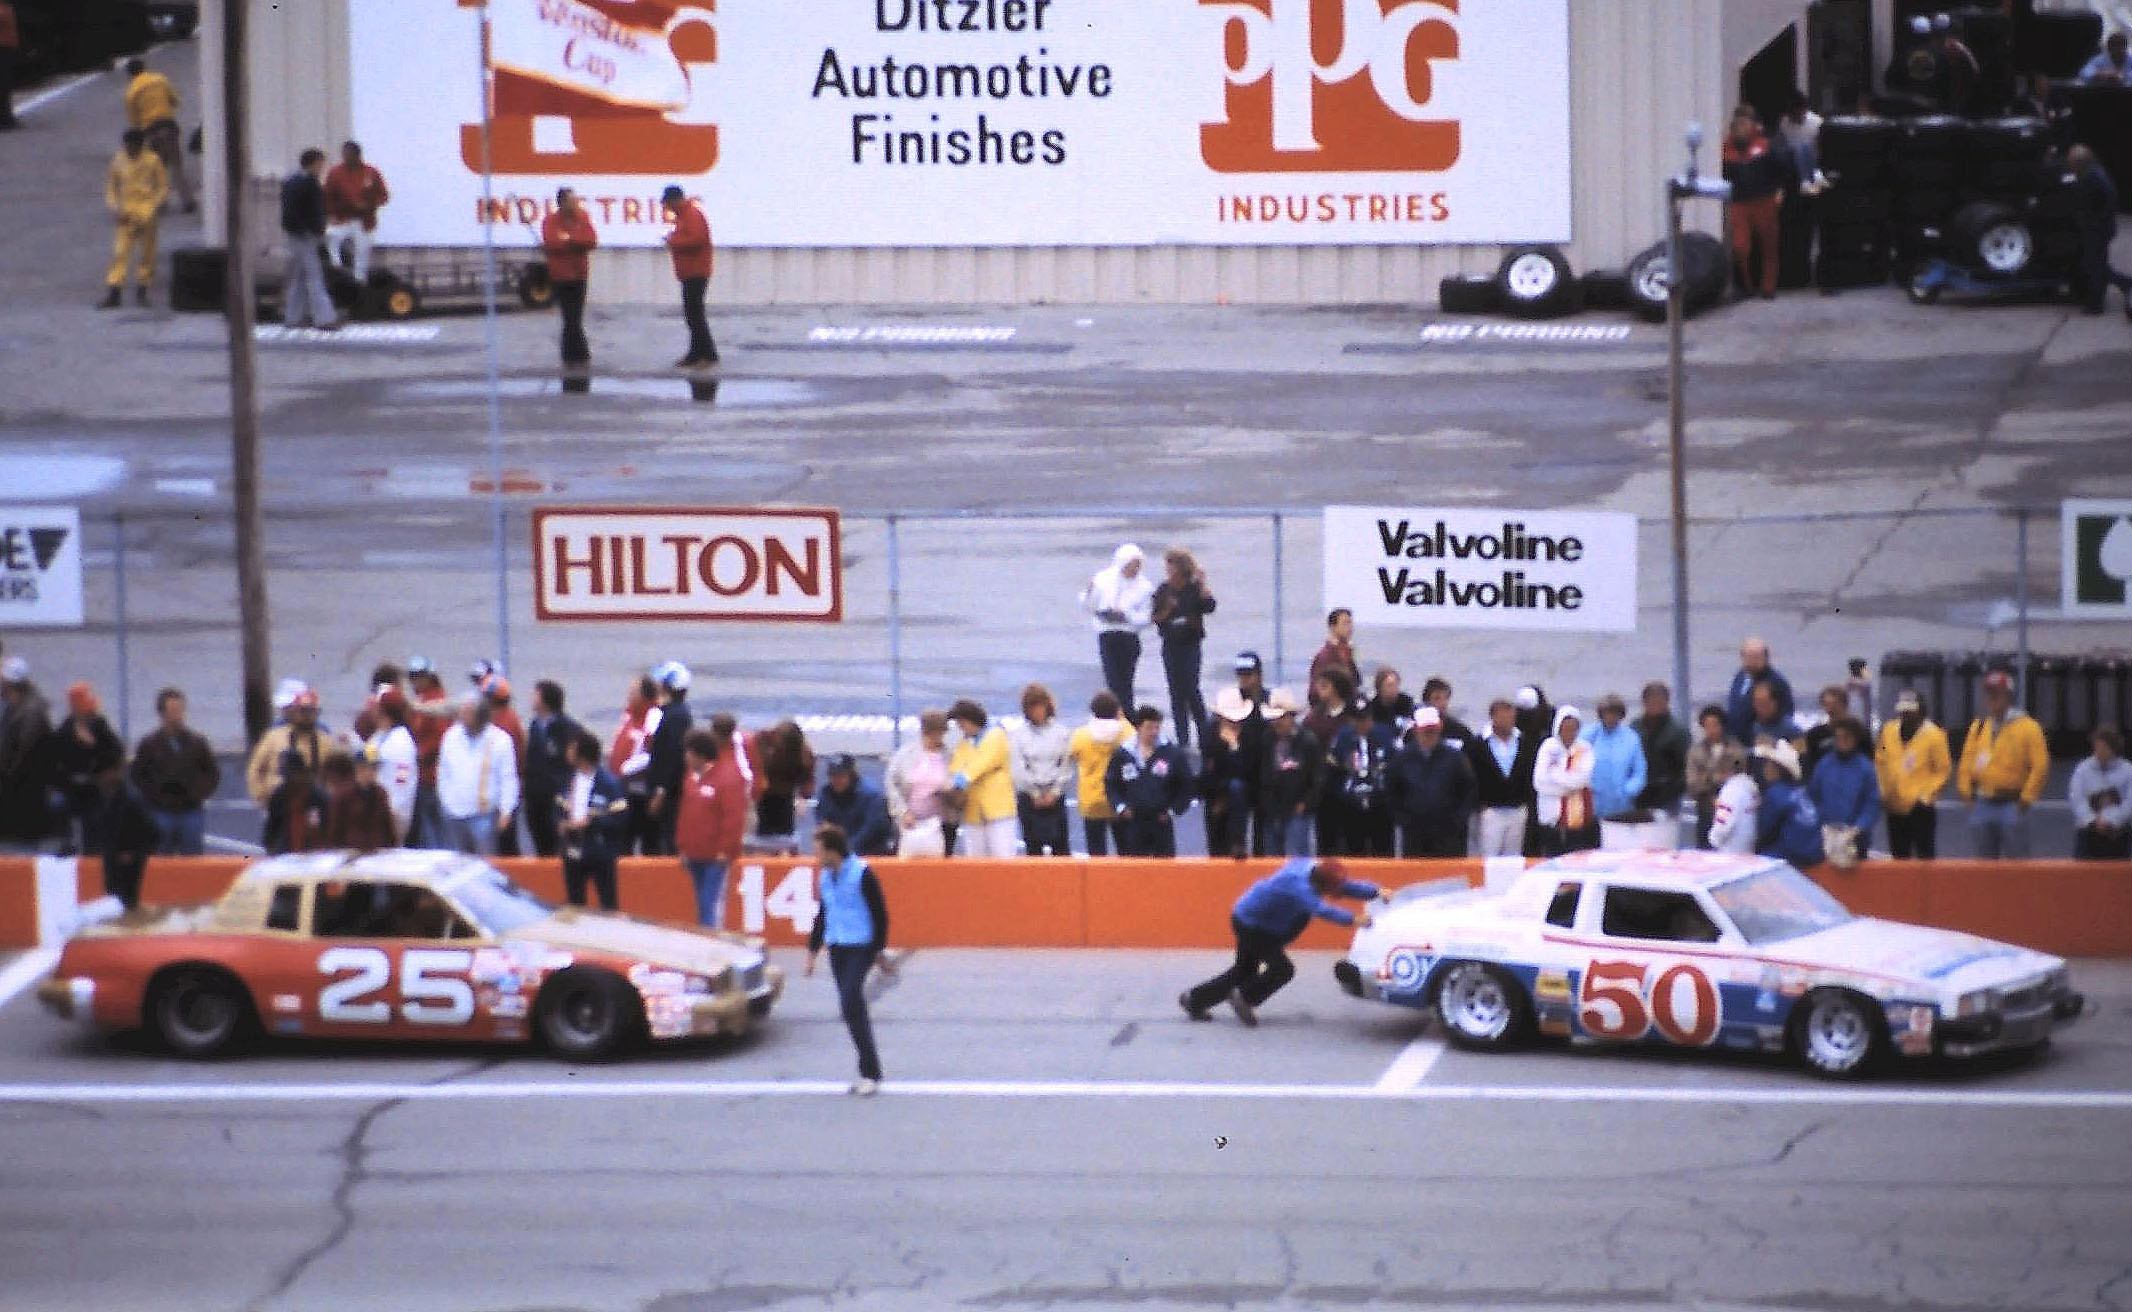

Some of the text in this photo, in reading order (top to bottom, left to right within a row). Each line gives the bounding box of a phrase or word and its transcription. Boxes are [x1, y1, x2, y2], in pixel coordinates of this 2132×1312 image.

[876, 0, 1051, 31] Ditzler
[812, 47, 1113, 98] Automotive
[852, 113, 1066, 165] Finishes
[1218, 194, 1450, 222] INDUSTRIES
[1377, 518, 1584, 562] Valvoline
[554, 535, 820, 597] HILTON
[1377, 566, 1584, 610] Valvoline
[738, 865, 820, 935] 14
[317, 946, 475, 1024] 25
[1580, 958, 1722, 1048] 50
